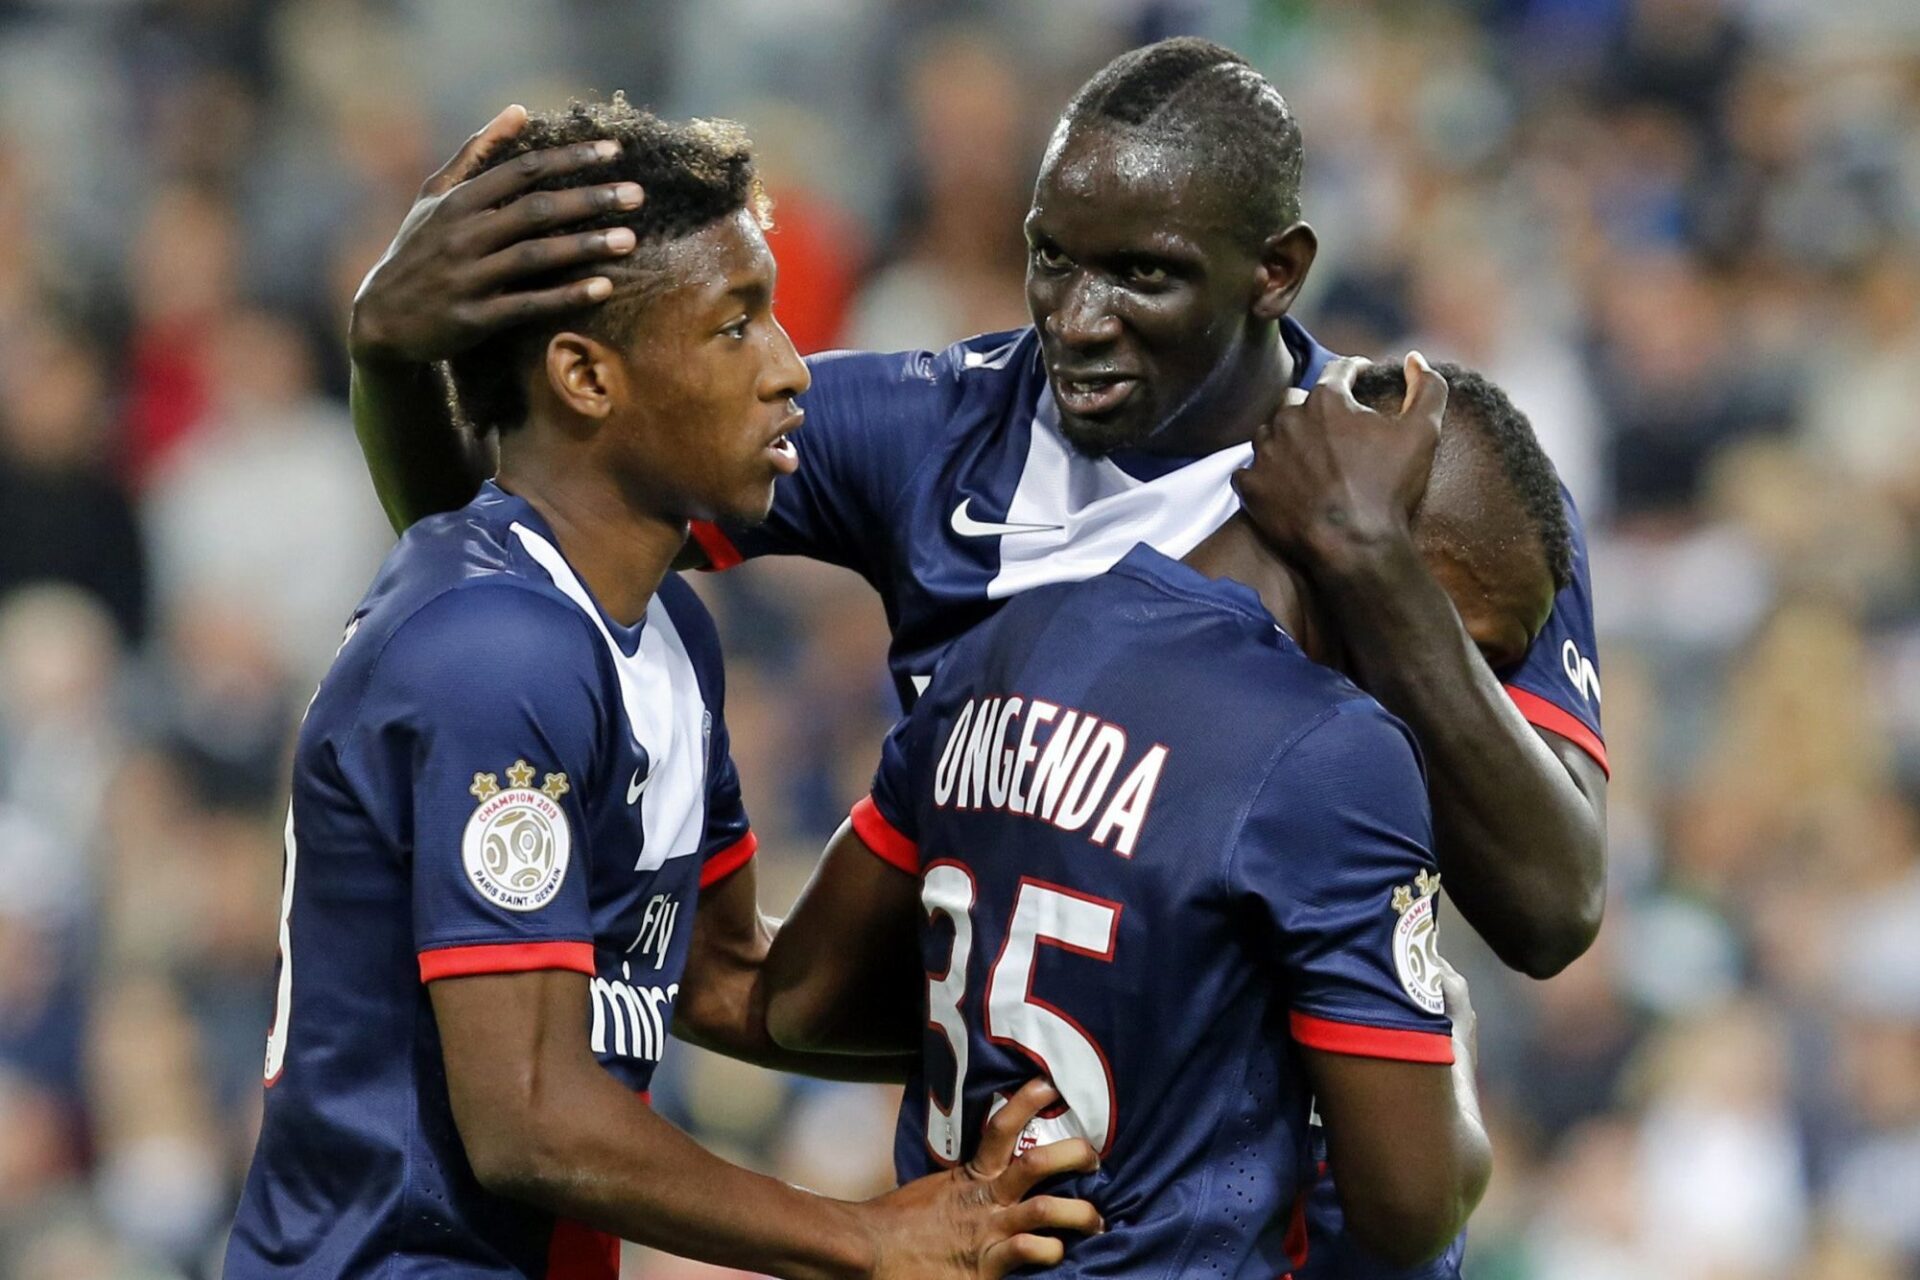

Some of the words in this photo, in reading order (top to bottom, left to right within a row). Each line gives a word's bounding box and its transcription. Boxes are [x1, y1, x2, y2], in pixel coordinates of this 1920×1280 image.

[478, 793, 534, 823] CHAMPION
[934, 696, 1169, 858] ONGENDA
[474, 870, 499, 897] PARIS
[500, 893, 528, 907] SAINT
[535, 867, 561, 903] GERMAIN
[626, 893, 680, 970] Fly
[589, 960, 680, 1062] mir
[921, 859, 1123, 1167] 35
